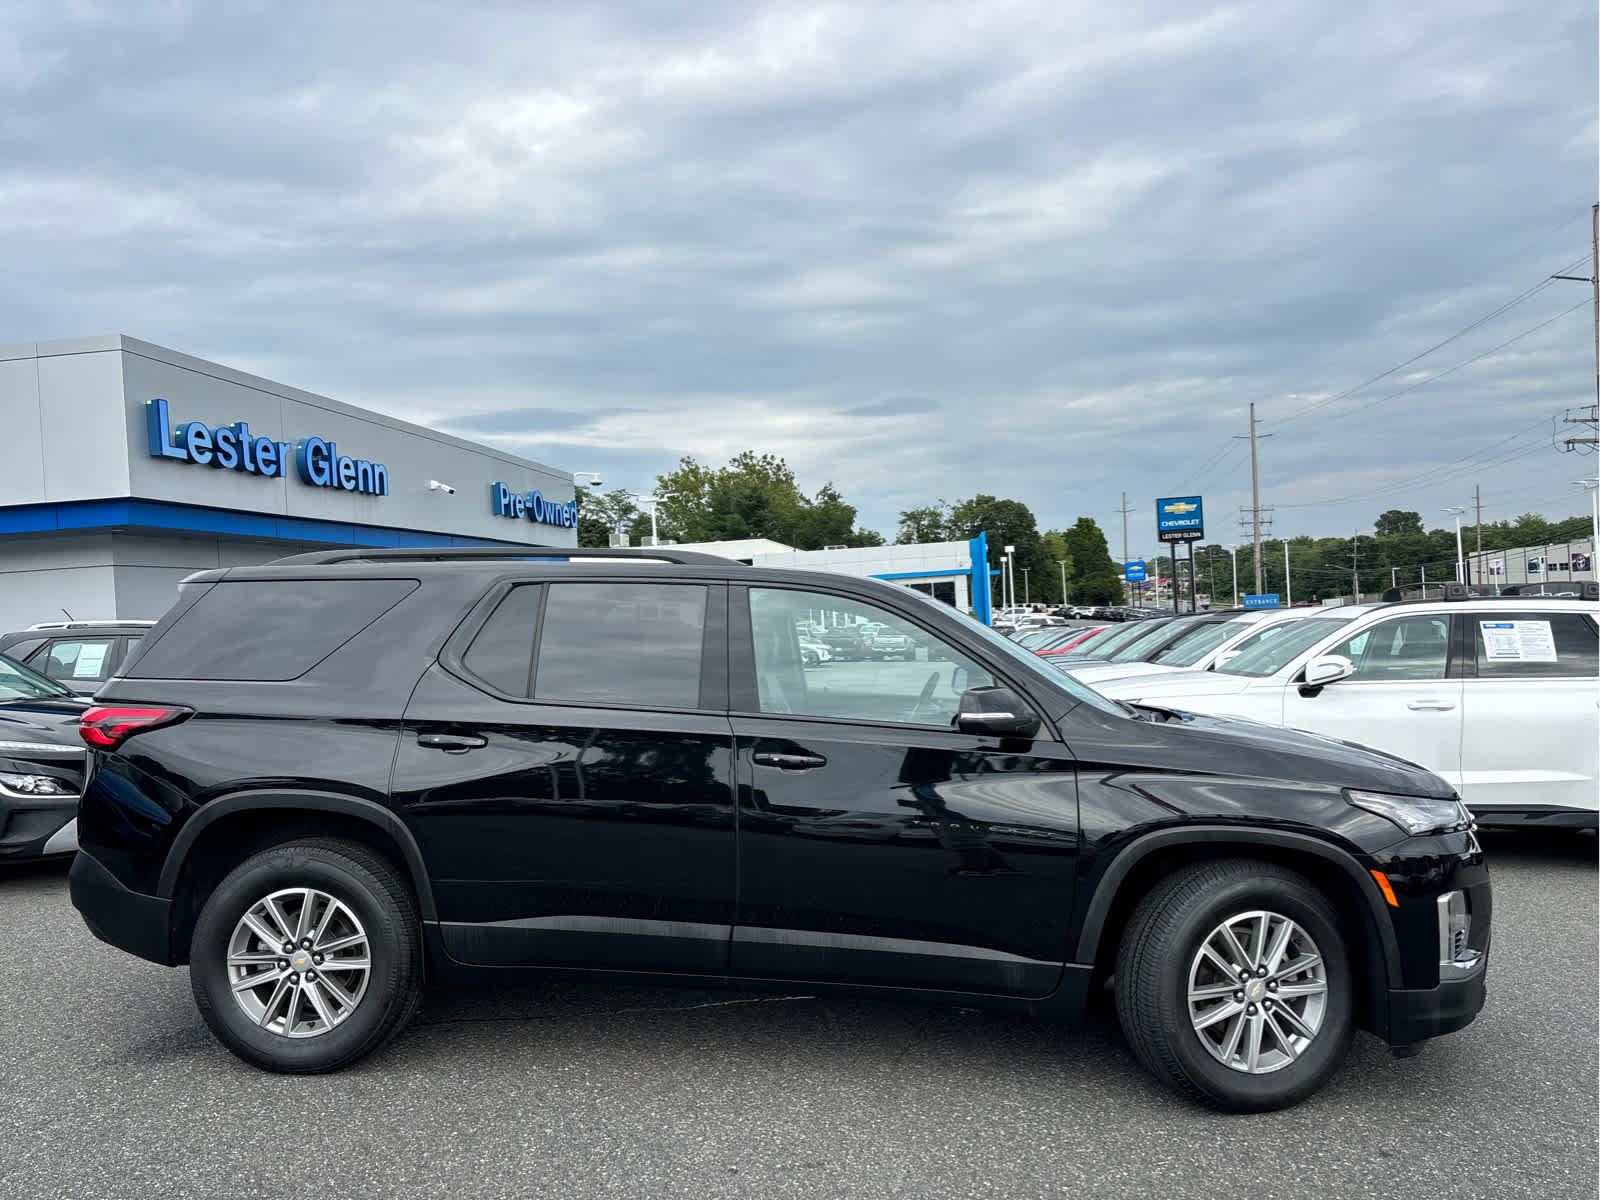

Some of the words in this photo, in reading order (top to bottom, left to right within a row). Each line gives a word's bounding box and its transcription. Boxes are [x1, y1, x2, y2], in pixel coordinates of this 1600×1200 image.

[144, 399, 289, 478] Lester
[296, 437, 389, 496] Glenn
[492, 482, 578, 528] Pre-Owned
[1161, 519, 1200, 527] CHEVROLET
[1162, 532, 1182, 540] LESTER
